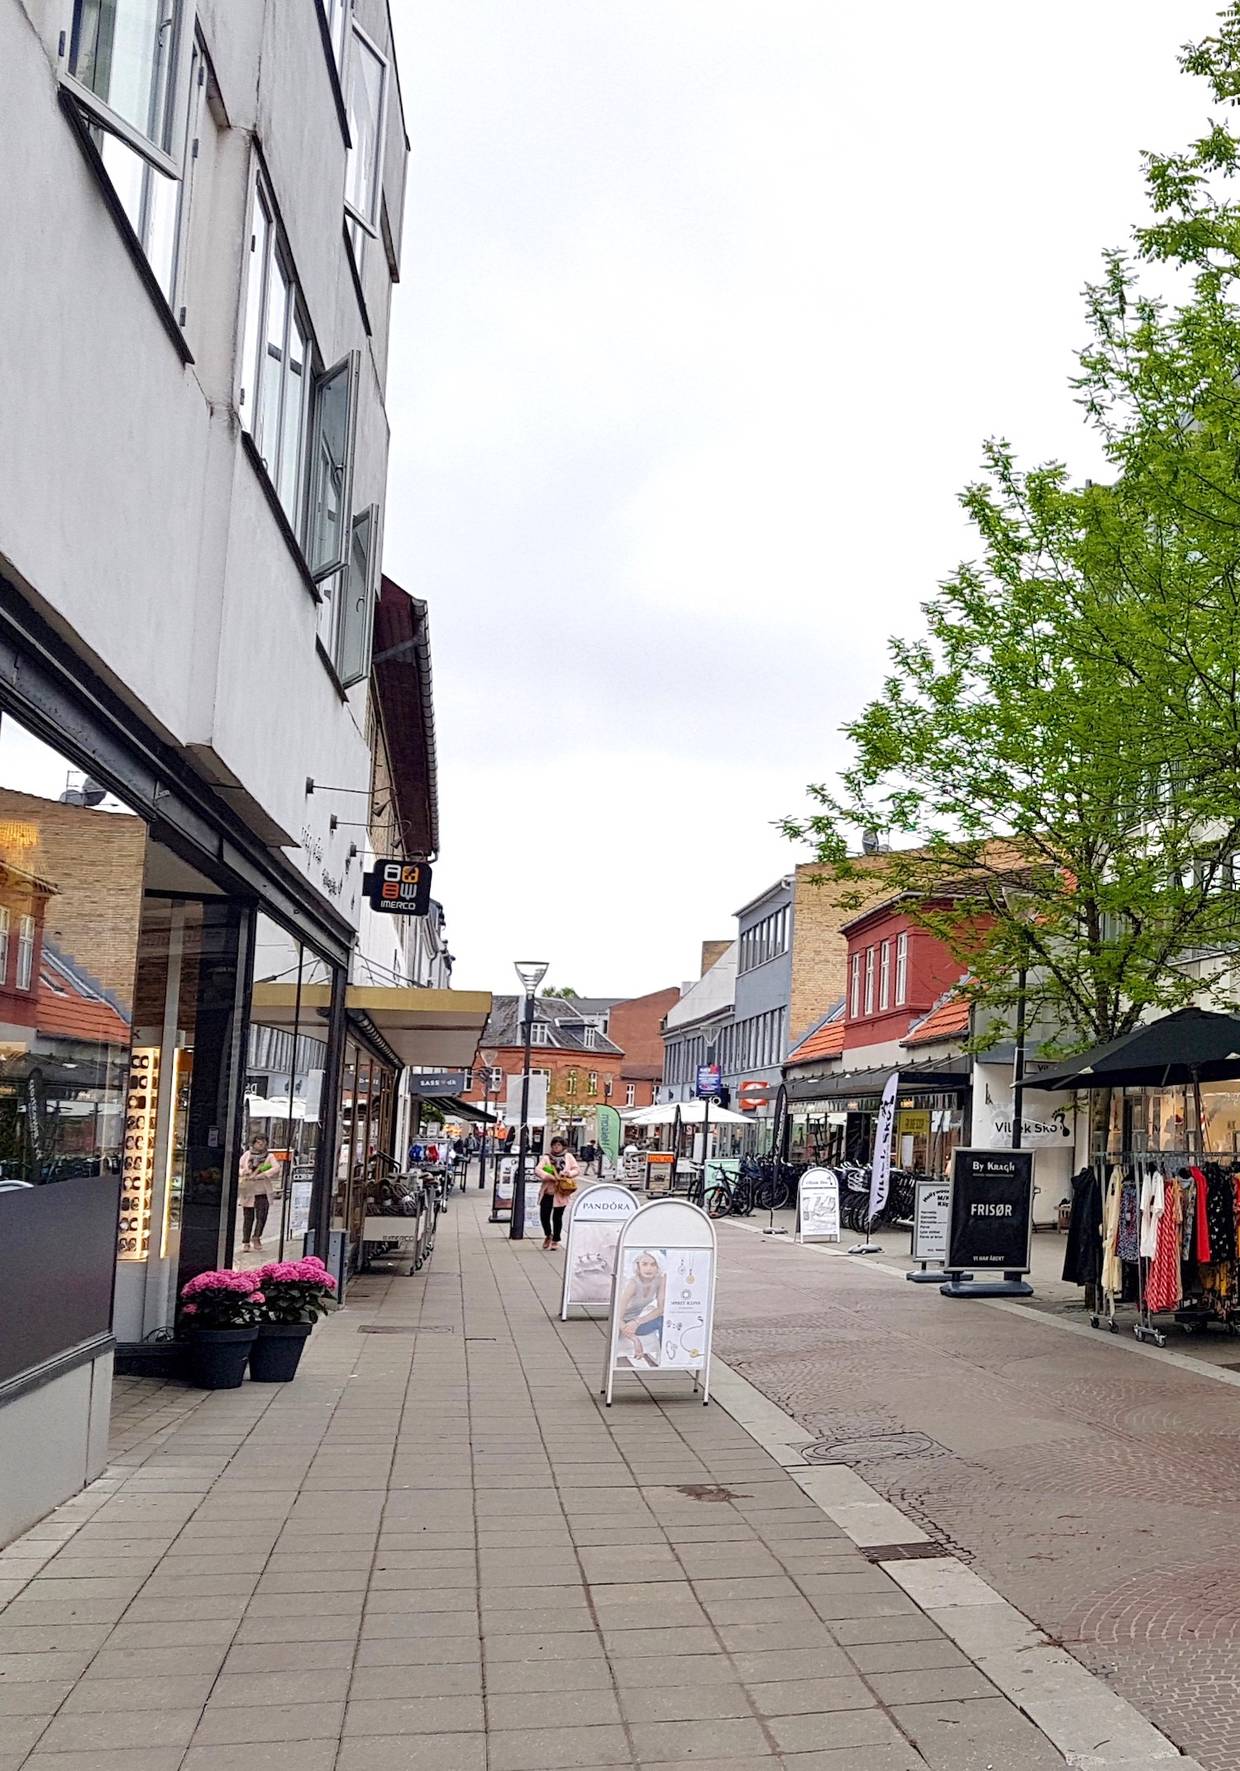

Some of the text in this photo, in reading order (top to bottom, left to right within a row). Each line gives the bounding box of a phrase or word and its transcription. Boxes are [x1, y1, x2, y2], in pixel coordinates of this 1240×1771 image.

[380, 900, 416, 910] IMERCO
[972, 1161, 1015, 1174] By Kragh
[582, 1201, 631, 1211] PANDORA
[970, 1203, 1013, 1217] FRISØR
